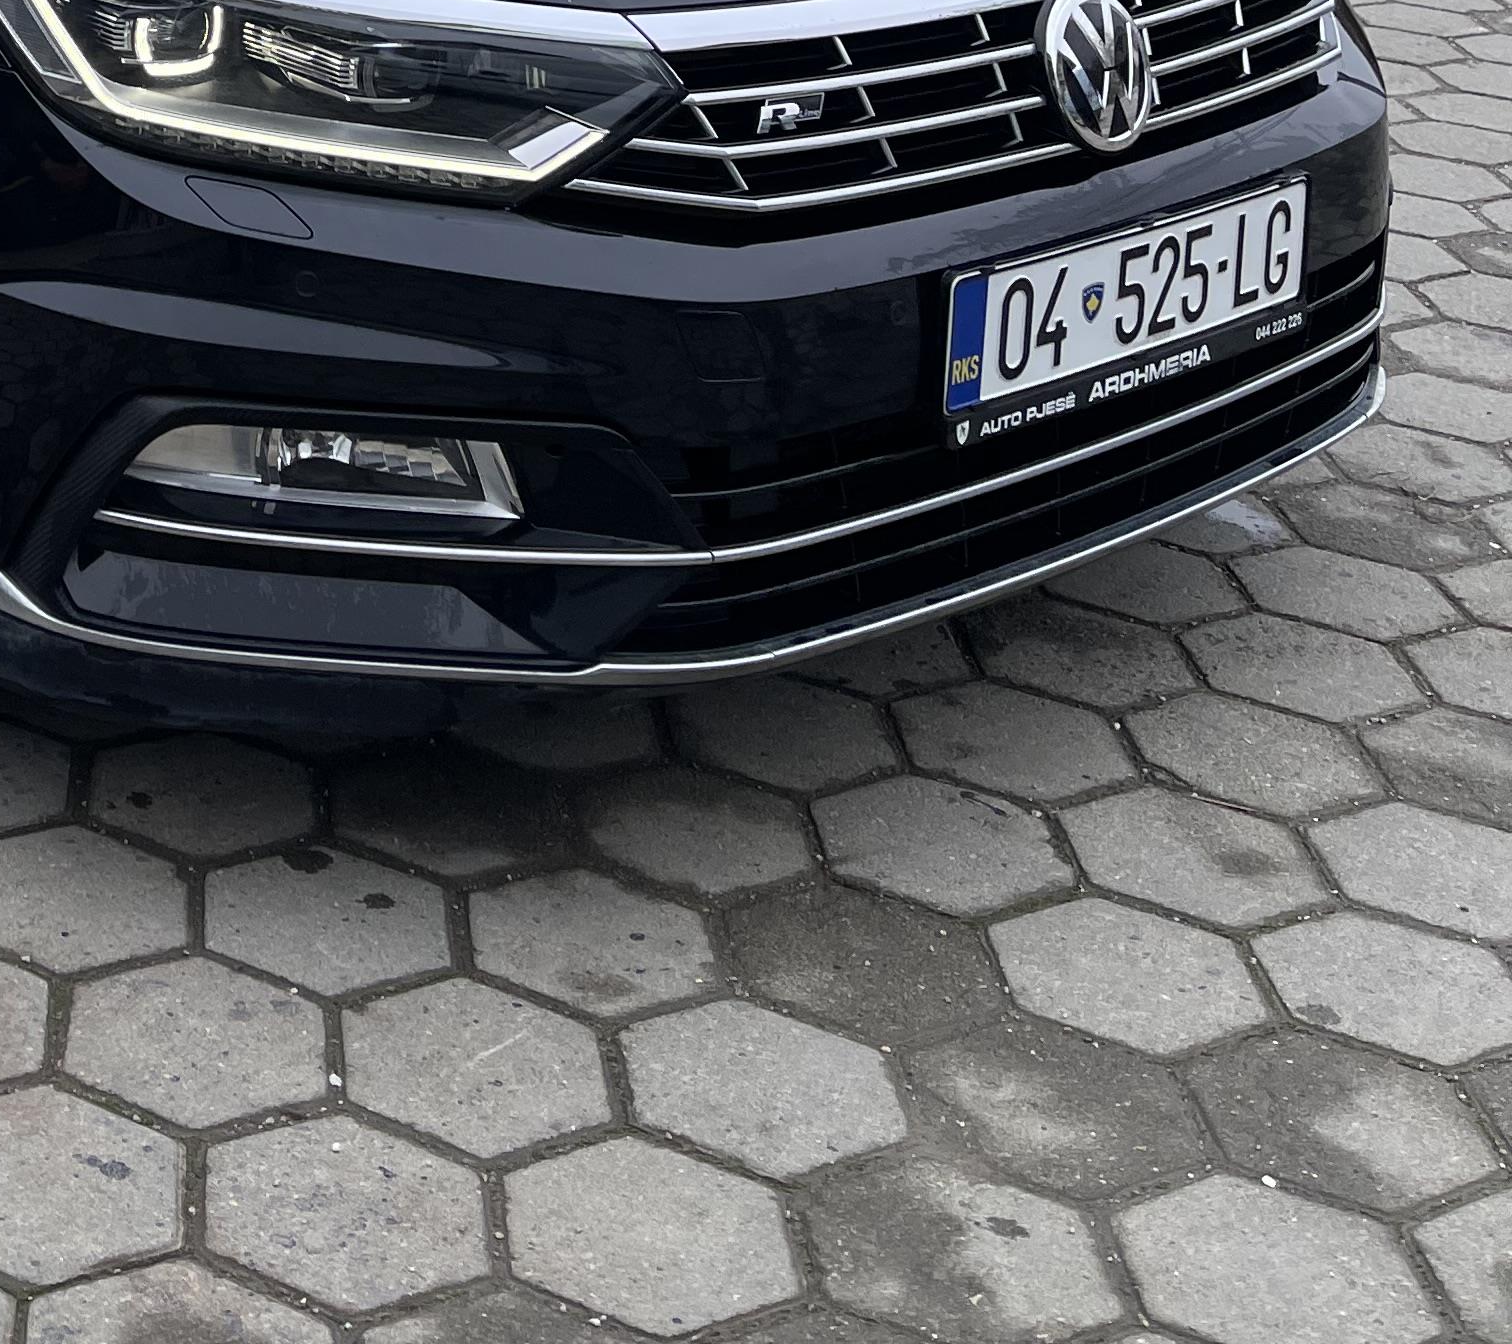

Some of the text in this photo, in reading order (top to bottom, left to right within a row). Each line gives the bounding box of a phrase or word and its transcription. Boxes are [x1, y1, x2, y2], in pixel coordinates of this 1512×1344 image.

[998, 199, 1291, 381] 04 525-LG
[951, 354, 980, 386] RKS
[979, 344, 1211, 438] AUTO PJESË ARDHMERIA
